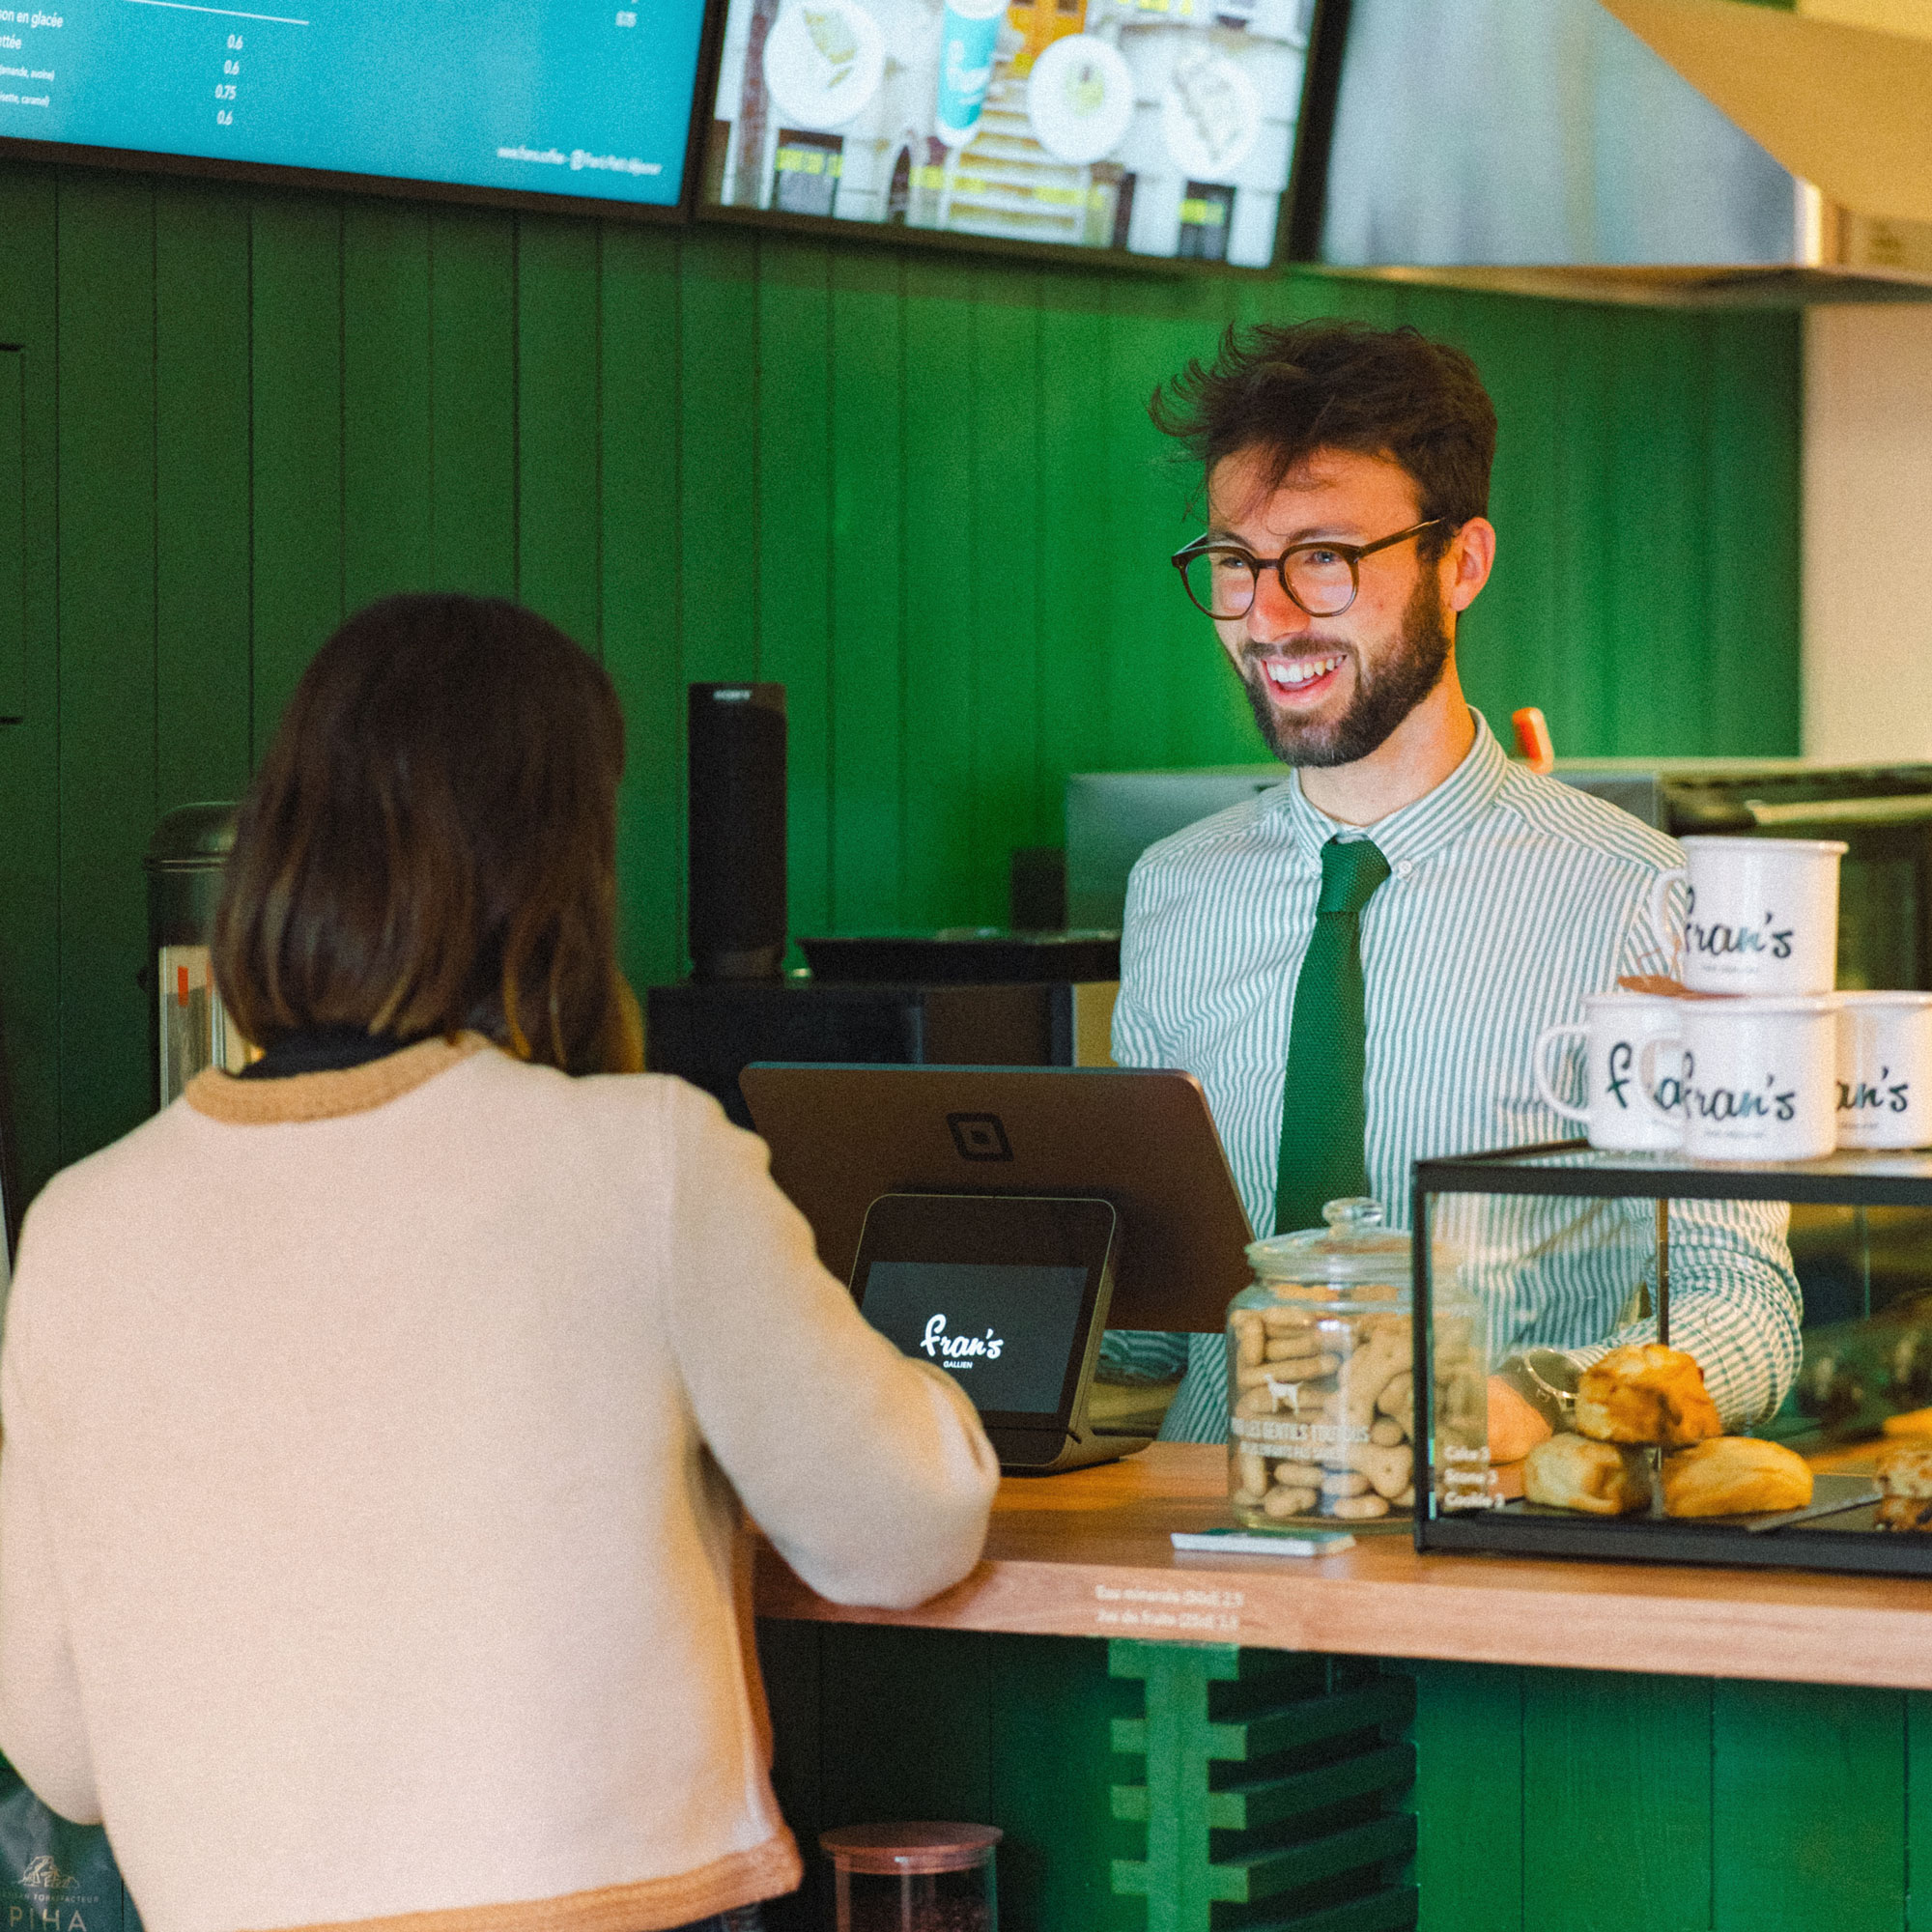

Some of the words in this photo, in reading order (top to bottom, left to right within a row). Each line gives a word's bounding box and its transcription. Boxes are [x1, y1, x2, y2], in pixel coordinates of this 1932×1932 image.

[16, 12, 29, 24] en
[31, 10, 64, 29] glacée
[227, 34, 243, 50] 0.6
[223, 59, 241, 75] 0.6
[214, 83, 238, 100] 0.75
[216, 109, 233, 126] 0.6
[920, 1313, 1004, 1359] fran's
[943, 1360, 973, 1369] GALLIEN
[9, 1906, 87, 1932] PIHA
